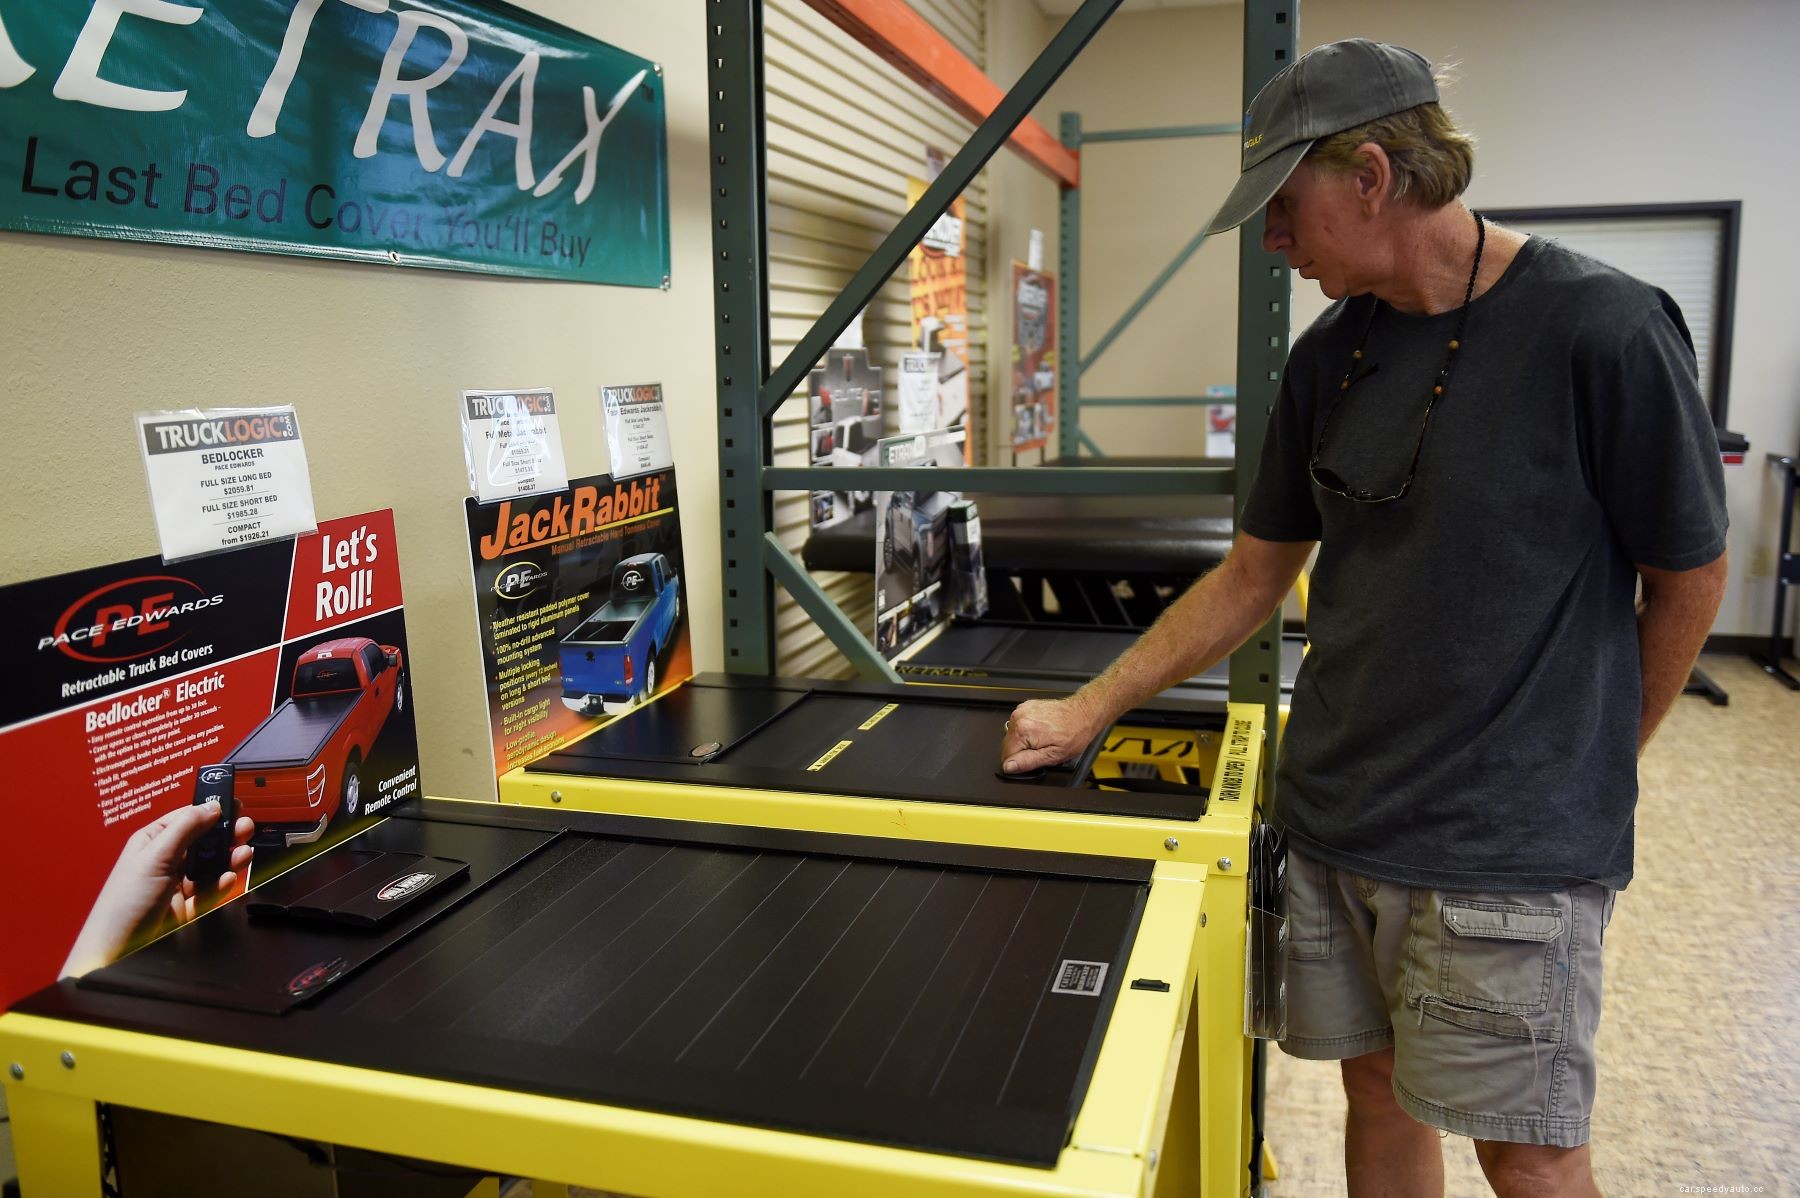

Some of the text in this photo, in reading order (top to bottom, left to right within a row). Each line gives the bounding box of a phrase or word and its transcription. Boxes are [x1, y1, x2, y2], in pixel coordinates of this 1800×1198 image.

[21, 135, 593, 267] Last Bed Cover You'll Buy
[201, 448, 264, 464] BEDLOCKER
[214, 461, 255, 471] PACE EDWARDS
[200, 471, 272, 488] FULL SIZE LONG BED
[223, 485, 254, 495] $2059.81
[202, 494, 278, 513] FULL SIZE SHORT BED
[227, 508, 258, 519] $1985.28
[221, 530, 269, 545] from $1926.21
[227, 521, 261, 533] COMPACT
[321, 525, 378, 574] Let's
[551, 543, 575, 556] Manual
[576, 533, 609, 549] Retractable
[505, 569, 532, 592] PE
[315, 570, 373, 622] Roll!
[516, 608, 539, 622] resistant
[539, 602, 558, 617] padded
[558, 595, 577, 609] polymer
[577, 592, 590, 601] cover
[37, 594, 224, 651] PACE EDWARDS
[91, 592, 175, 648] PE
[521, 623, 528, 631] to
[528, 618, 540, 629] rigid
[540, 610, 564, 624] aluminum
[564, 604, 580, 618] panels
[496, 627, 555, 655] 100% no-drill advanced
[497, 643, 542, 665] mounting system
[61, 643, 213, 697] Retractable Truck Bed Covers
[498, 658, 540, 680] Multiple locking
[176, 671, 225, 703] Electric
[499, 675, 525, 692] positions
[500, 692, 509, 701] on
[509, 686, 522, 698] long
[527, 678, 541, 689] short
[542, 673, 552, 683] bed
[501, 696, 525, 711] versions
[524, 704, 539, 716] cargo
[539, 698, 551, 709] light
[104, 728, 123, 739] remote
[123, 721, 142, 733] control
[142, 714, 166, 727] operation
[166, 710, 178, 719] from
[504, 710, 549, 736] for night visibility
[540, 730, 557, 743] design
[378, 765, 416, 792] Convenient
[364, 781, 417, 815] Remote Control
